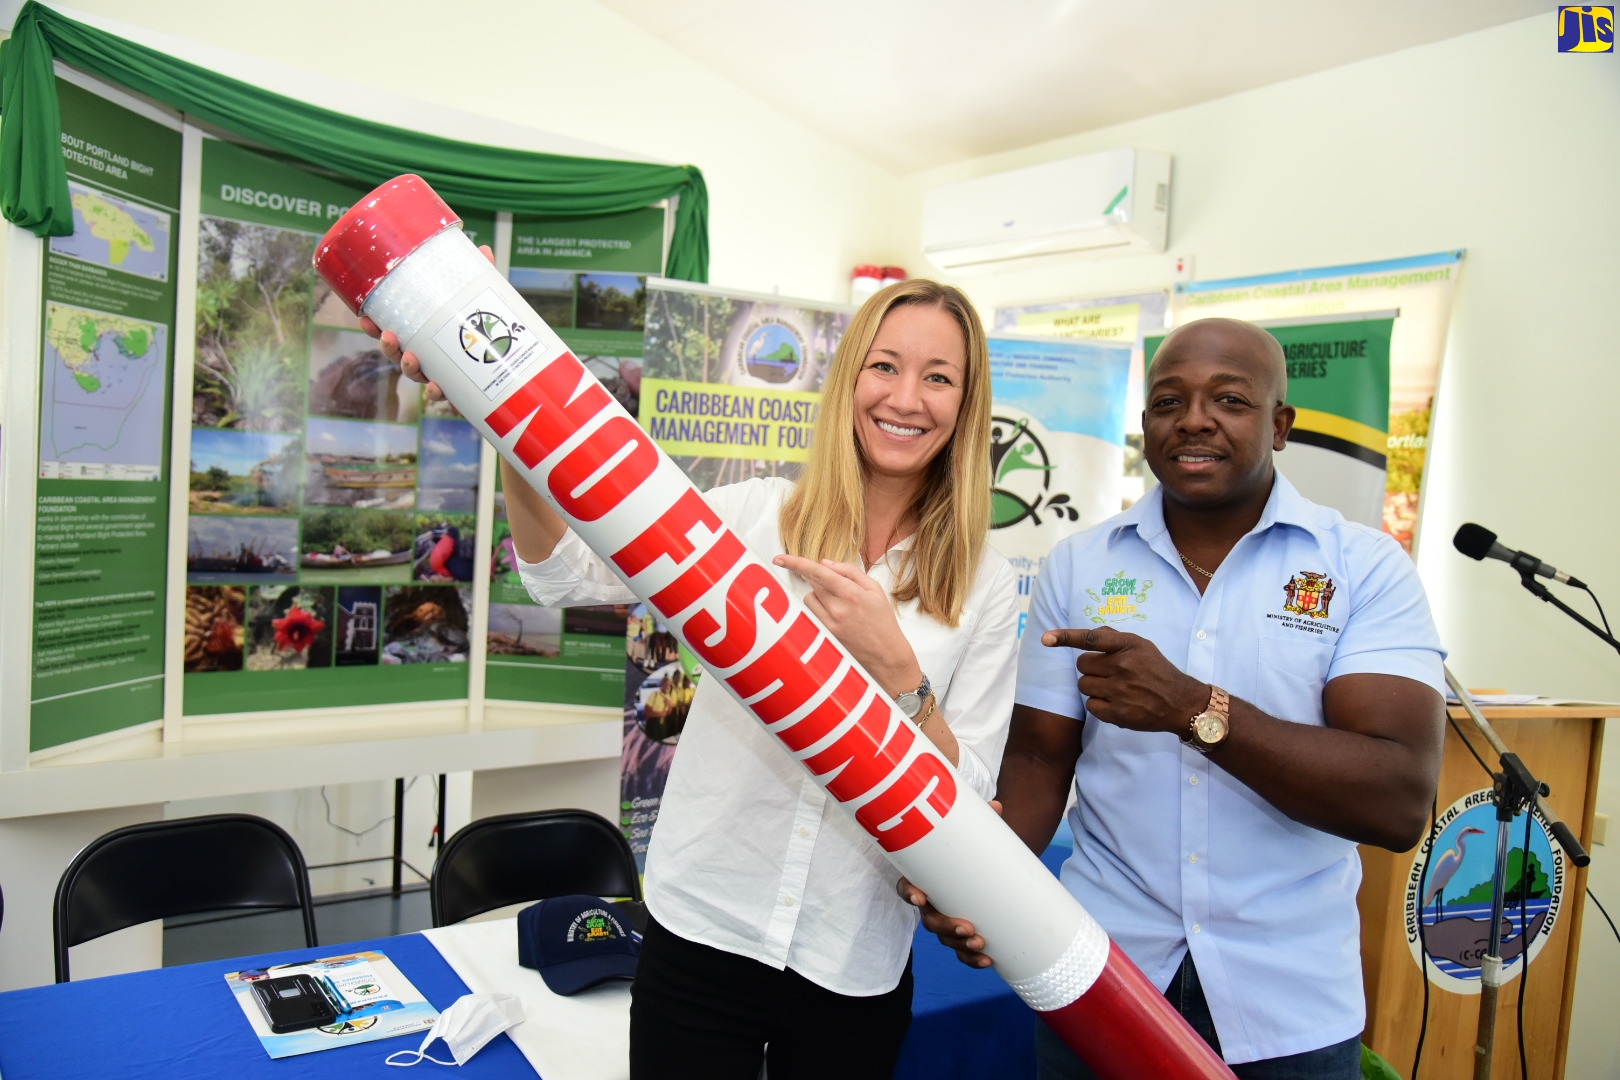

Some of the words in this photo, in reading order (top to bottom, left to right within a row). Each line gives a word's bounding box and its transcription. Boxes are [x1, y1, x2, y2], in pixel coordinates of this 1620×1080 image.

[61, 133, 84, 150] BOUT
[86, 142, 130, 168] PORTLAND
[130, 160, 154, 176] BIGHT
[61, 147, 104, 171] ROTECTED
[106, 166, 128, 180] AREA
[220, 184, 322, 218] DISCOVER
[516, 236, 534, 245] THE
[536, 238, 577, 248] LARGEST
[579, 240, 632, 250] PROTECTED
[516, 247, 541, 256] AREA
[542, 248, 552, 256] IN
[553, 248, 592, 258] JAMAICA
[1186, 289, 1250, 306] Caribbean
[1253, 284, 1308, 300] Coastal
[1310, 280, 1343, 294] Area
[1347, 267, 1452, 290] Management
[1052, 316, 1081, 327] WHAT
[1082, 314, 1102, 326] ARE
[656, 388, 754, 418] CARIBBEAN
[650, 416, 770, 447] MANAGEMENT
[1104, 578, 1137, 587] GROW
[484, 352, 659, 522] NO
[610, 487, 958, 853] FISHING
[1107, 596, 1129, 606] EAT
[1266, 614, 1293, 622] MINISTRY
[1303, 620, 1340, 634] AGRICULTURE
[1295, 624, 1324, 635] FISHERIES
[1406, 862, 1422, 944] CARIBBEAN
[1464, 790, 1494, 808] AREA
[1542, 848, 1563, 936] FOUNDATION
